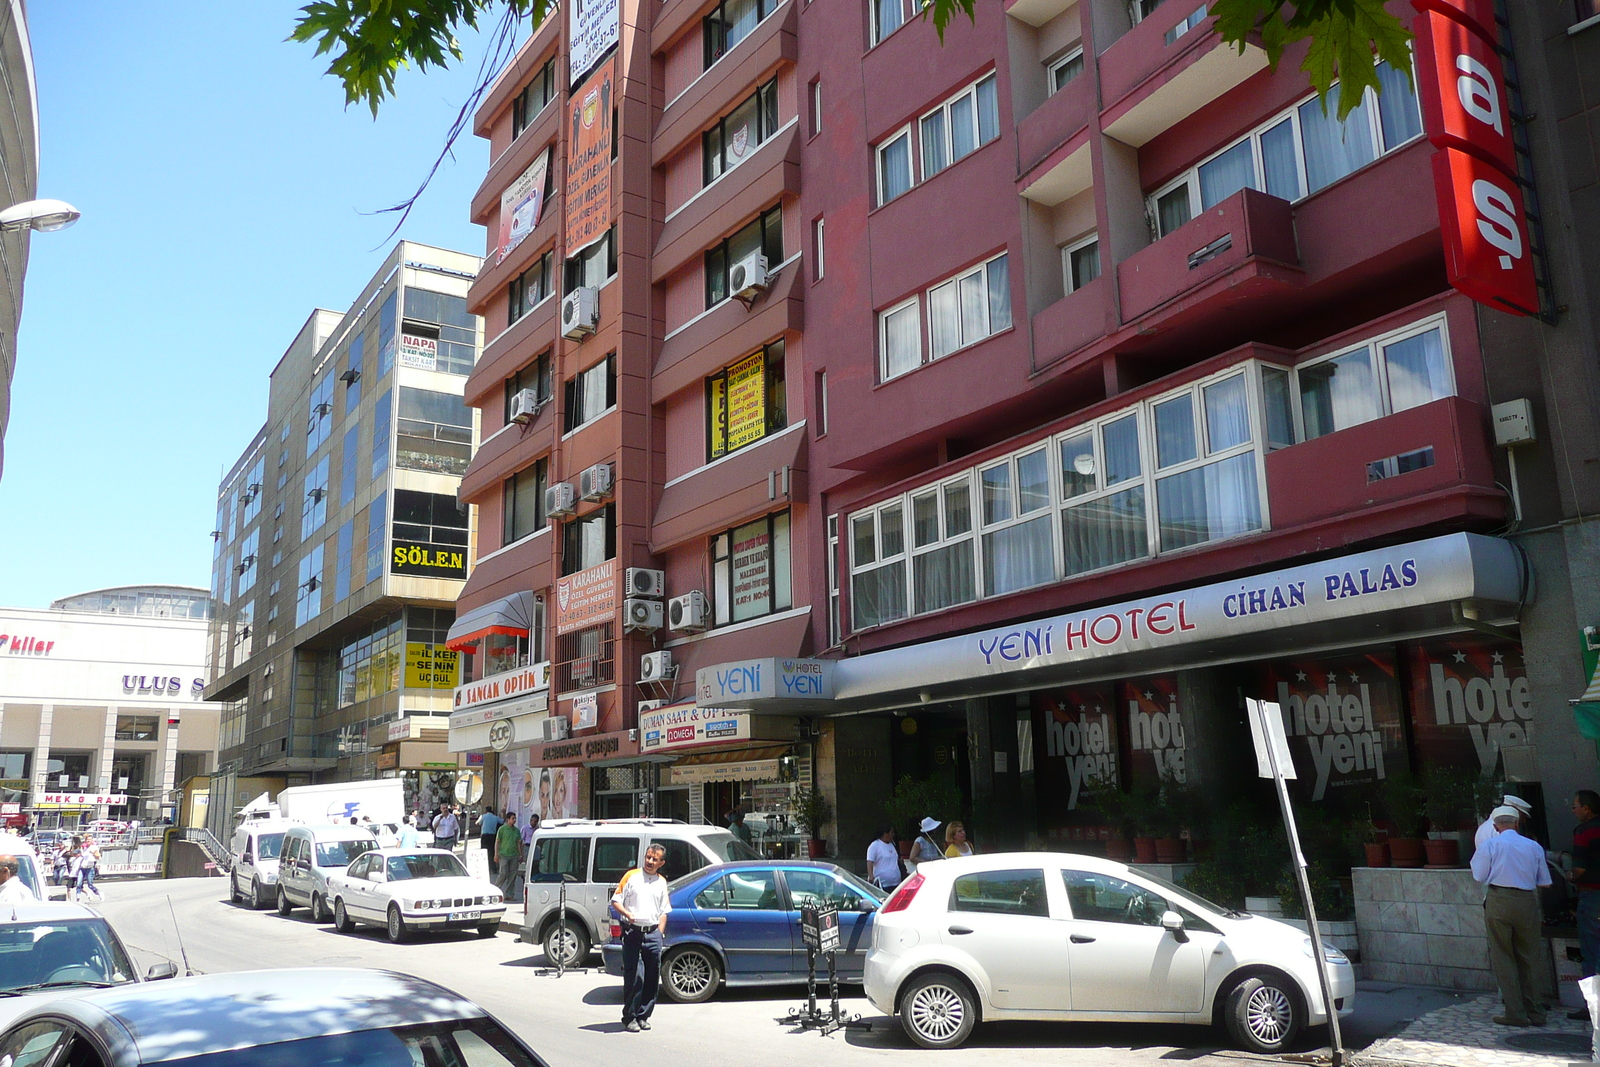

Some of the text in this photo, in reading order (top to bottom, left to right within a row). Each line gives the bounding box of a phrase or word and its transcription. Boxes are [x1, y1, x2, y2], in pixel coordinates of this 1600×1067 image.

[568, 132, 610, 178] KARAHANLI
[403, 336, 435, 349] NAPA
[394, 545, 463, 569] ŞÖLEN
[572, 562, 613, 590] KARAHANLI
[571, 579, 614, 600] ÖZEL GÜVENLİK
[571, 589, 614, 610] EĞİTİM MERKEZİ
[979, 558, 1418, 666] YENİ HOTEL CİHAN PALAS
[9, 635, 55, 655] kiler
[416, 661, 454, 671] SENİN
[797, 663, 823, 674] HOTEL
[122, 675, 182, 694] ULUS
[466, 670, 536, 704] SANCAK OPTİK
[716, 663, 761, 696] YENİ
[782, 675, 823, 694] YENİ
[1430, 663, 1533, 725] hote
[484, 710, 494, 720] ece
[643, 708, 743, 730] DUMAN SAAT & OPT
[1277, 682, 1373, 737] hotel
[490, 725, 510, 743] ece
[673, 729, 694, 738] OMEGA
[708, 722, 730, 730] swatch
[1045, 711, 1110, 757] hotel
[1129, 700, 1185, 750] hot
[543, 737, 619, 760] ALSANCAK ÇARŞISI
[1307, 731, 1386, 802] yeni
[1065, 753, 1117, 811] yeni
[45, 795, 71, 803] MEK
[462, 911, 469, 919] NE
